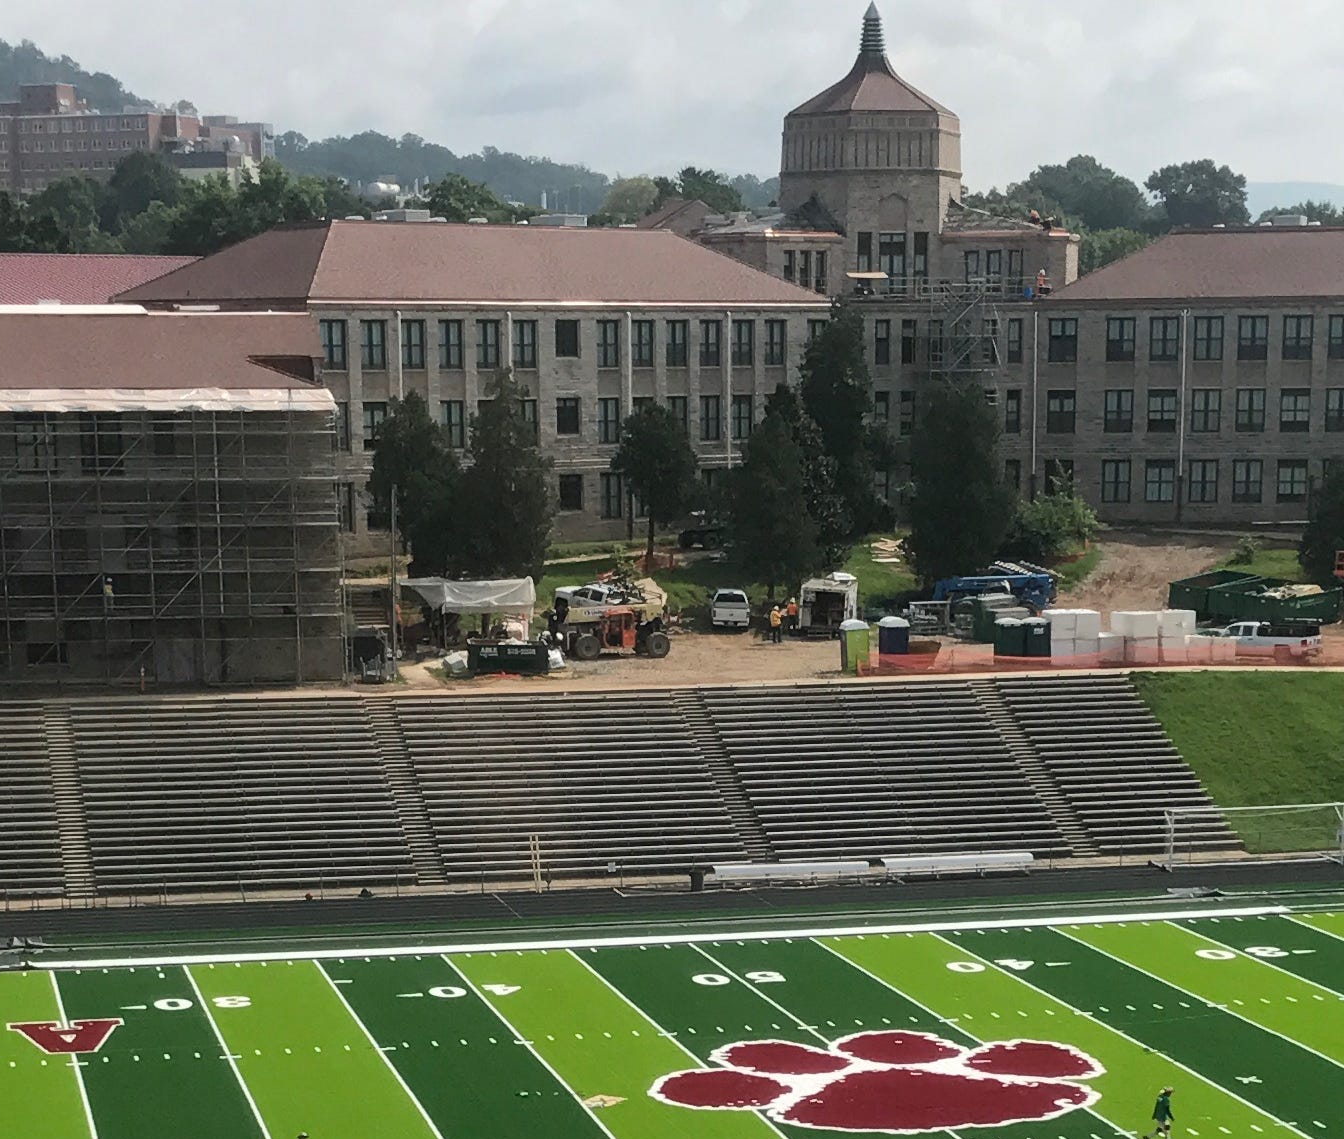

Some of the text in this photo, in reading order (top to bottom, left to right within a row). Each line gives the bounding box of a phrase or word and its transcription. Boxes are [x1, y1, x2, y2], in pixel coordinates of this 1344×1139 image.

[1194, 945, 1293, 960] 30
[946, 958, 1036, 973] 40
[691, 970, 786, 986] 50
[428, 983, 522, 998] 40
[153, 995, 252, 1012] 30
[6, 1018, 124, 1054] A
